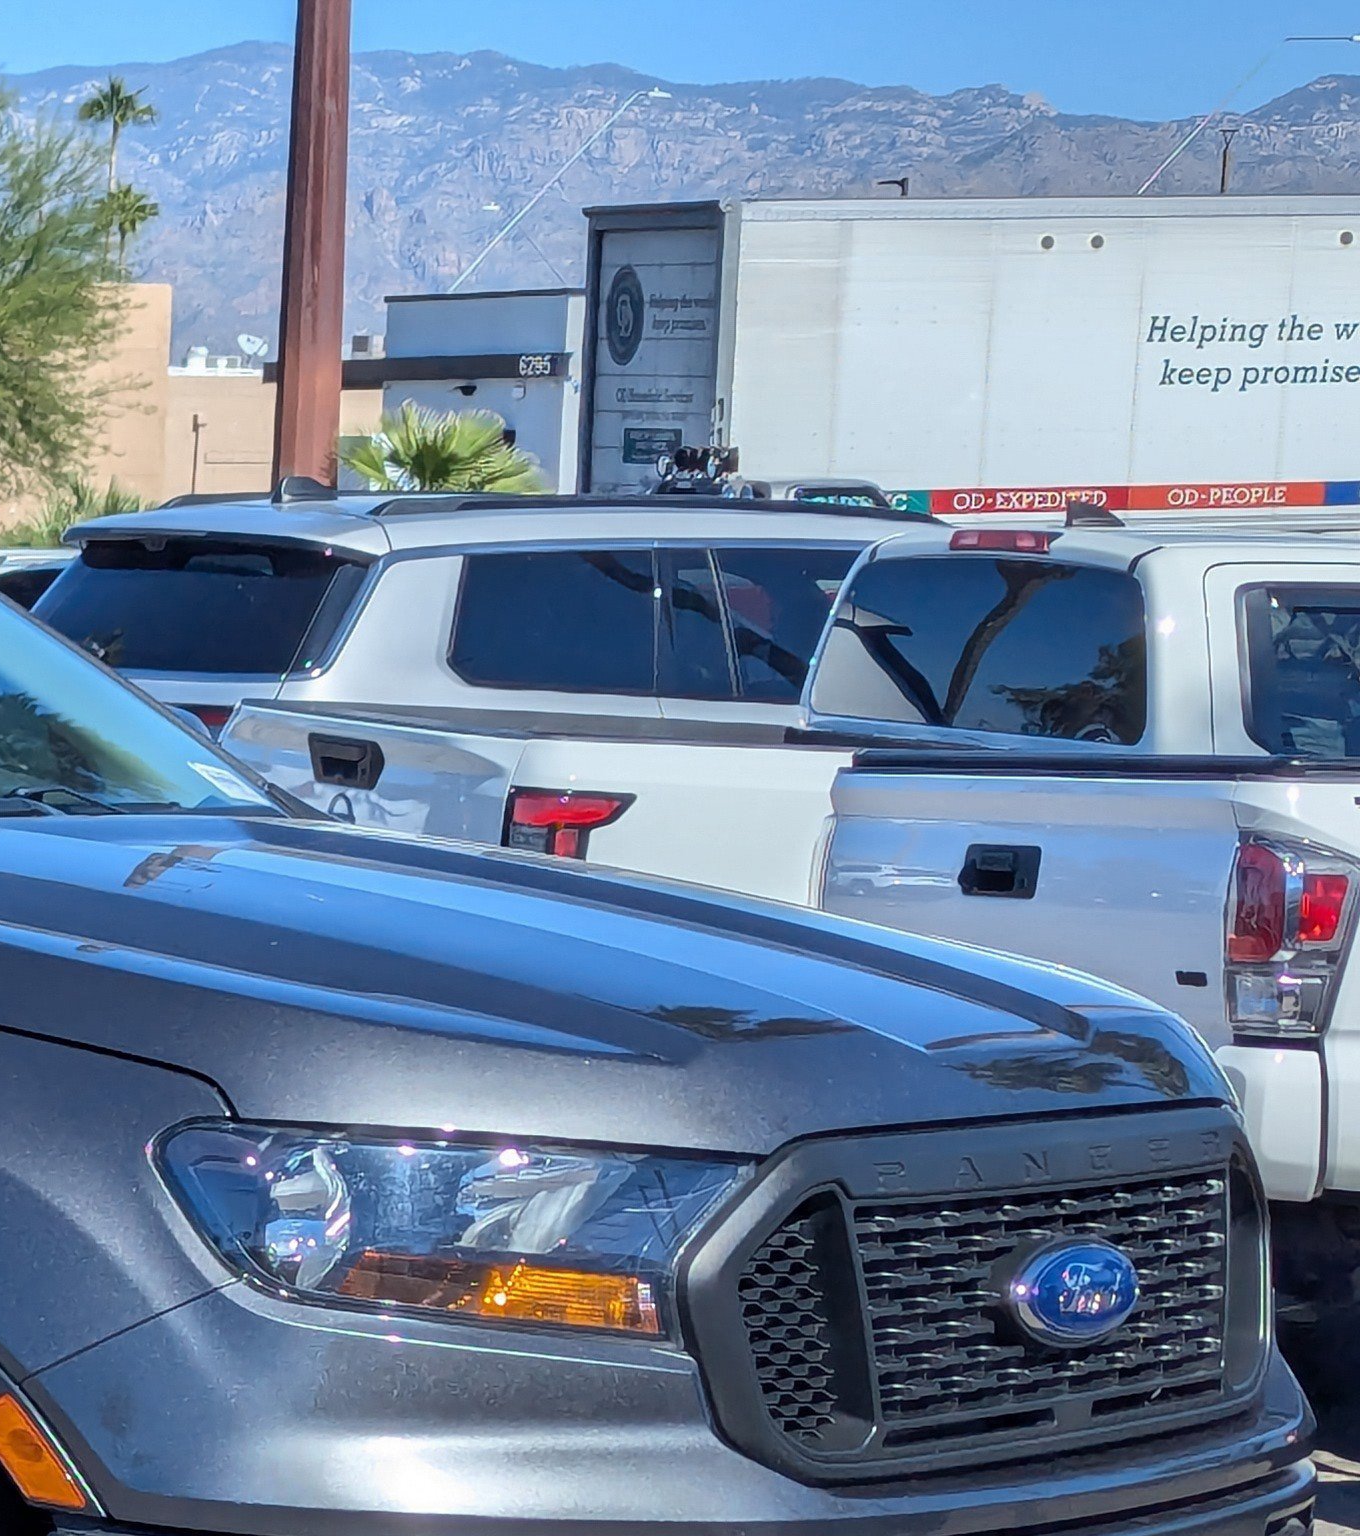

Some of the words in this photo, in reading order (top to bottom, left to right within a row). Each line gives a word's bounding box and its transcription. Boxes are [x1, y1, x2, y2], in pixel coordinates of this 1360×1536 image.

[1145, 314, 1269, 350] Helping
[1276, 313, 1325, 343] the
[1158, 358, 1233, 393] keep
[1166, 485, 1288, 506] OD-PEOPLE
